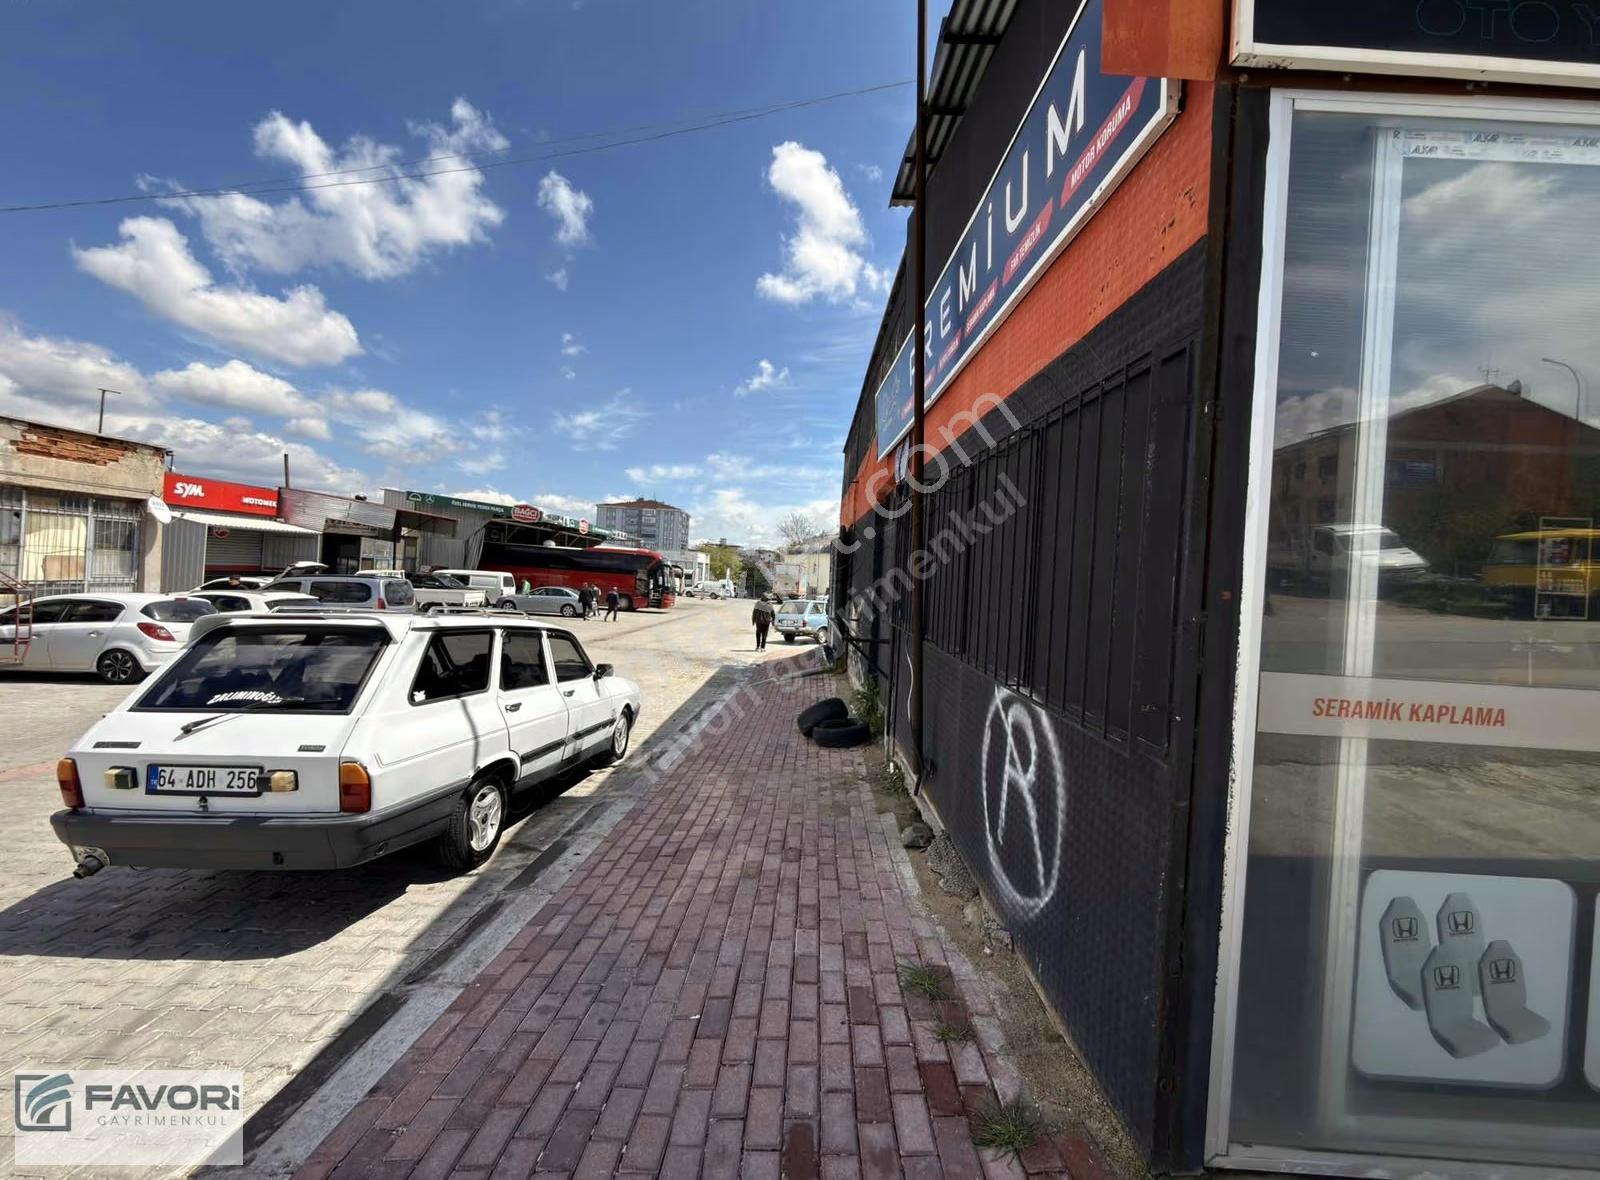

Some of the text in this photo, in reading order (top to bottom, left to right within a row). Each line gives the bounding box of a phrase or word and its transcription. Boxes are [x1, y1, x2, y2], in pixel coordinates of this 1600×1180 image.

[1070, 95, 1132, 190] MOTOR KORUMA
[1312, 697, 1506, 727] SERAMİK KAPLAMA
[158, 769, 256, 790] 64 ADH 256
